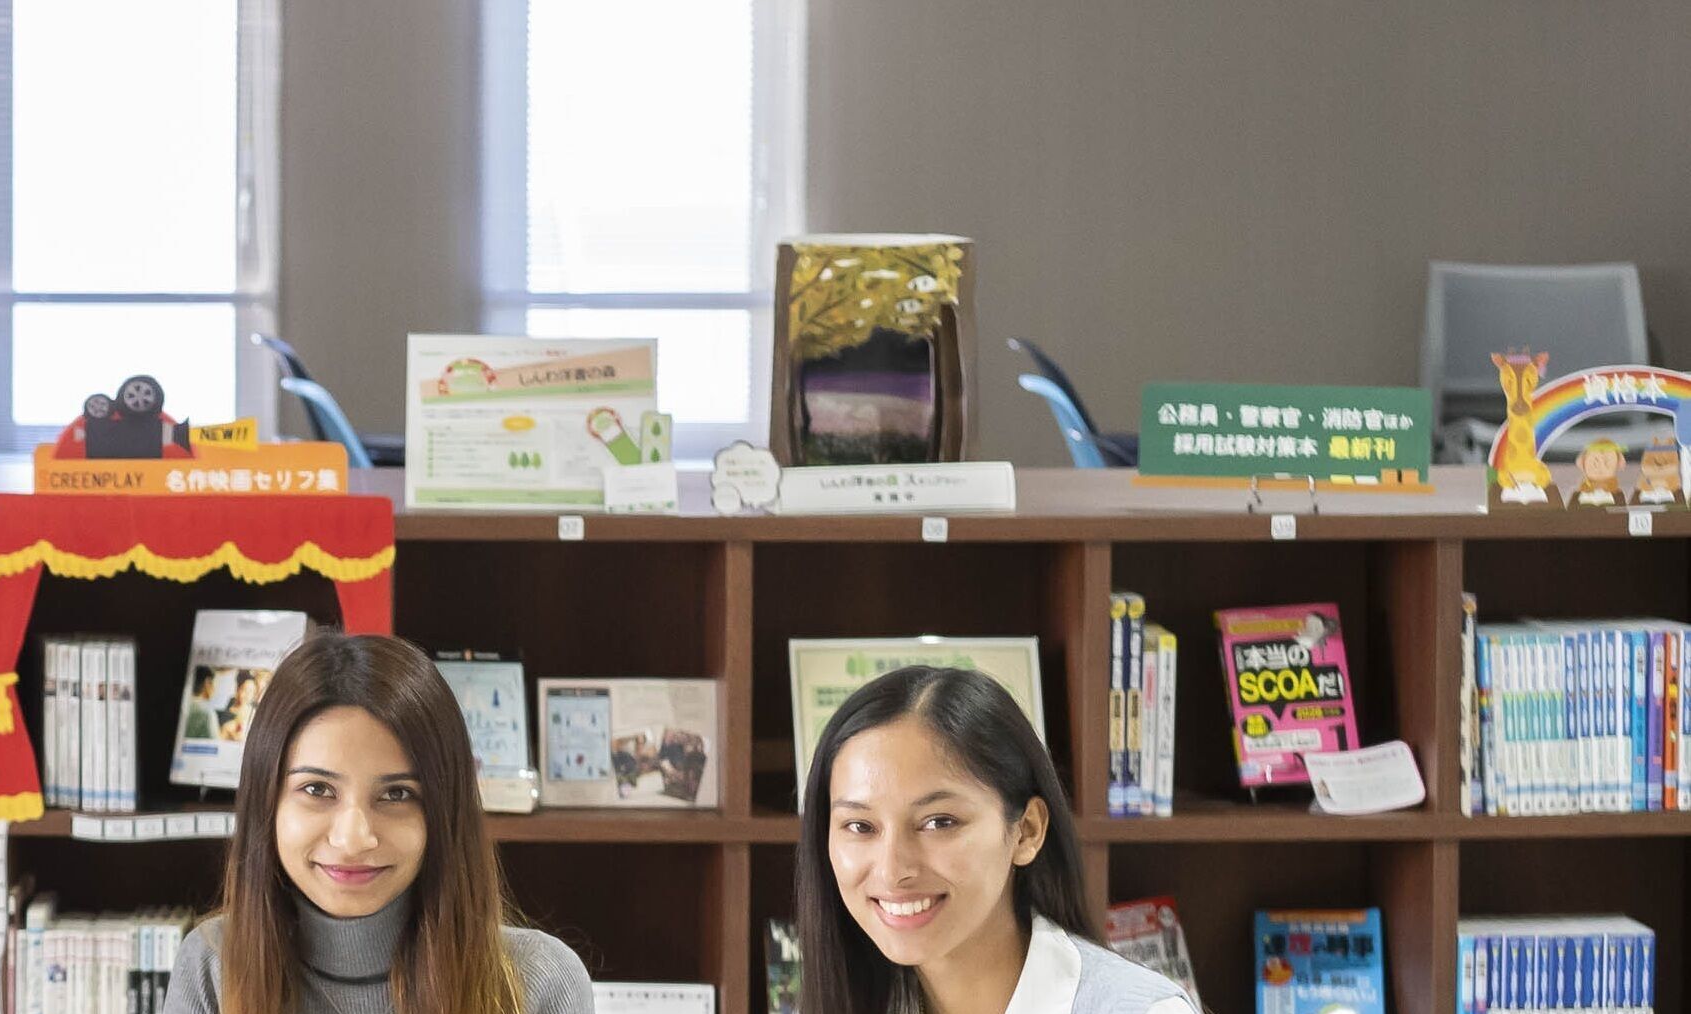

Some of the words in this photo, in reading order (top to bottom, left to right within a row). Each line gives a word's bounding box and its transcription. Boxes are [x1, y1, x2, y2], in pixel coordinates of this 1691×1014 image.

[1582, 372, 1669, 405] 資格本
[198, 426, 249, 441] NEW!!
[1328, 435, 1396, 460] 最新刊
[165, 467, 340, 492] 名作映画セリフ集
